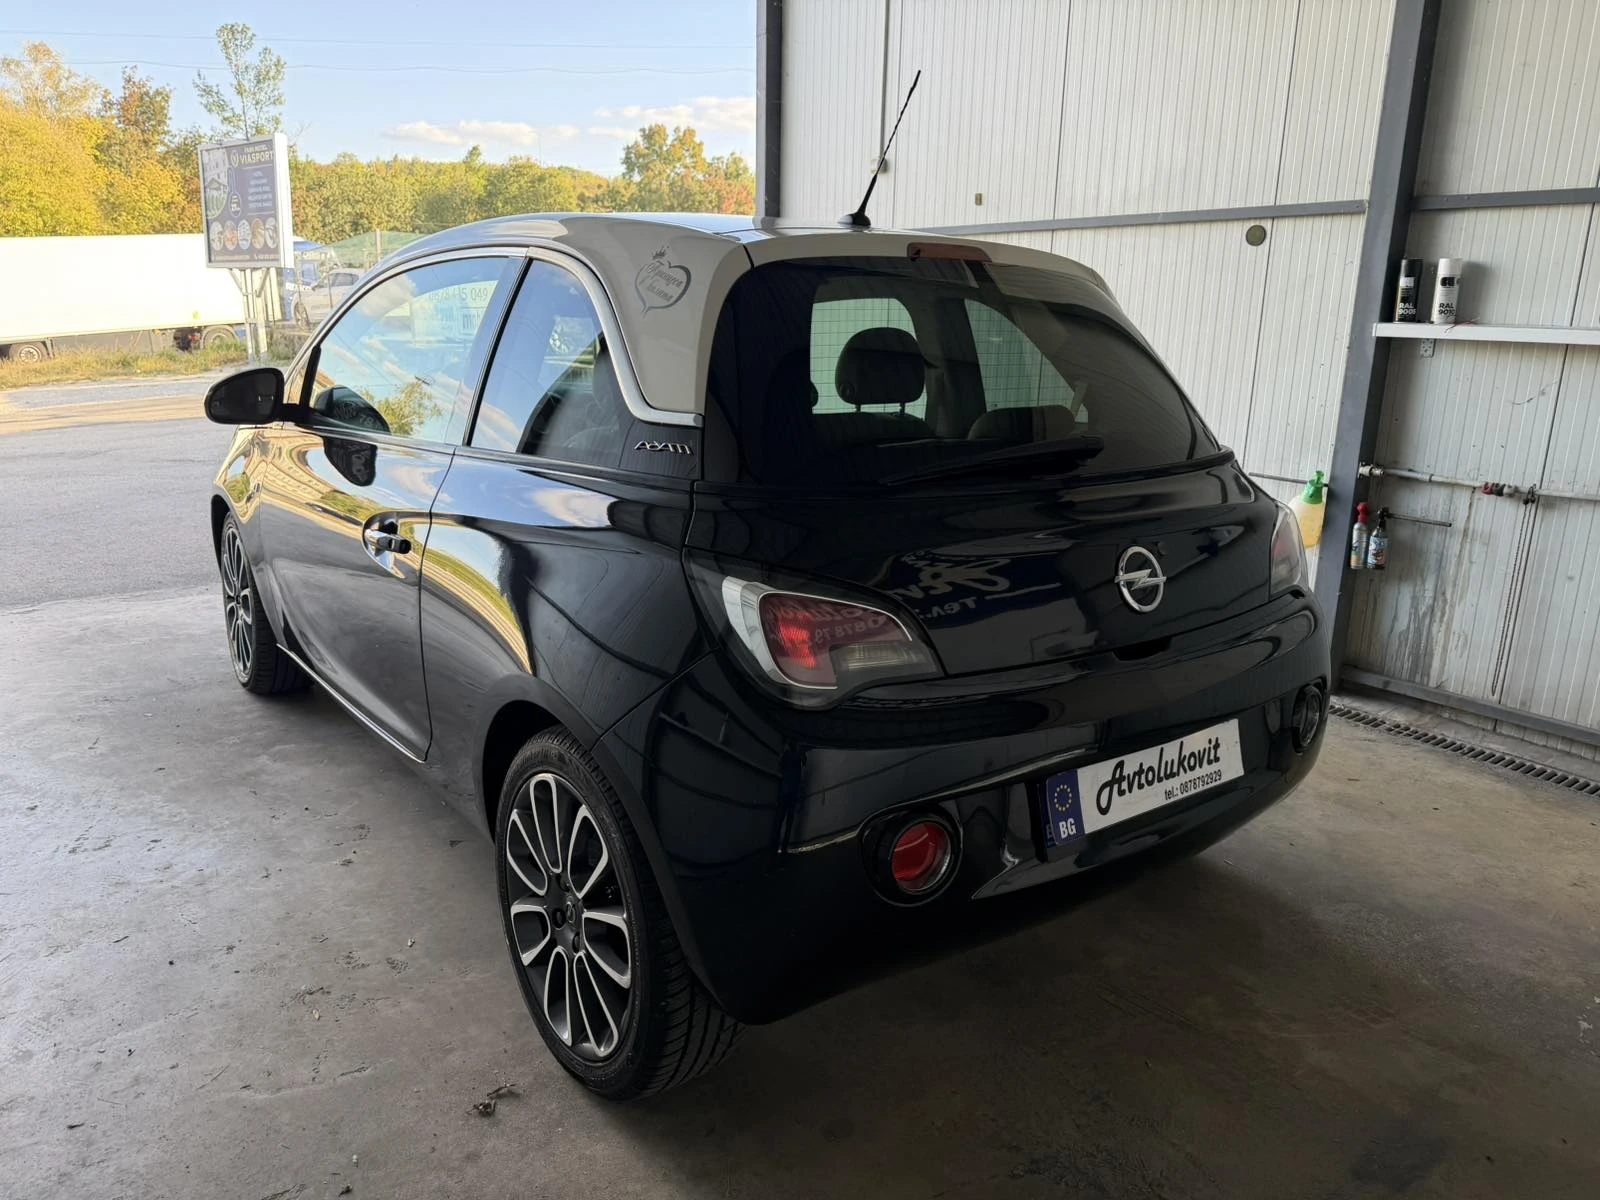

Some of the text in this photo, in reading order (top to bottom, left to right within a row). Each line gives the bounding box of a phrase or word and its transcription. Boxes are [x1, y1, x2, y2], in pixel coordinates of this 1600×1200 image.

[239, 151, 273, 164] VIASPORT
[470, 287, 488, 302] 049
[1096, 736, 1221, 816] Avtolukovit
[1179, 769, 1223, 796] 0878792929
[1059, 817, 1077, 839] BG
